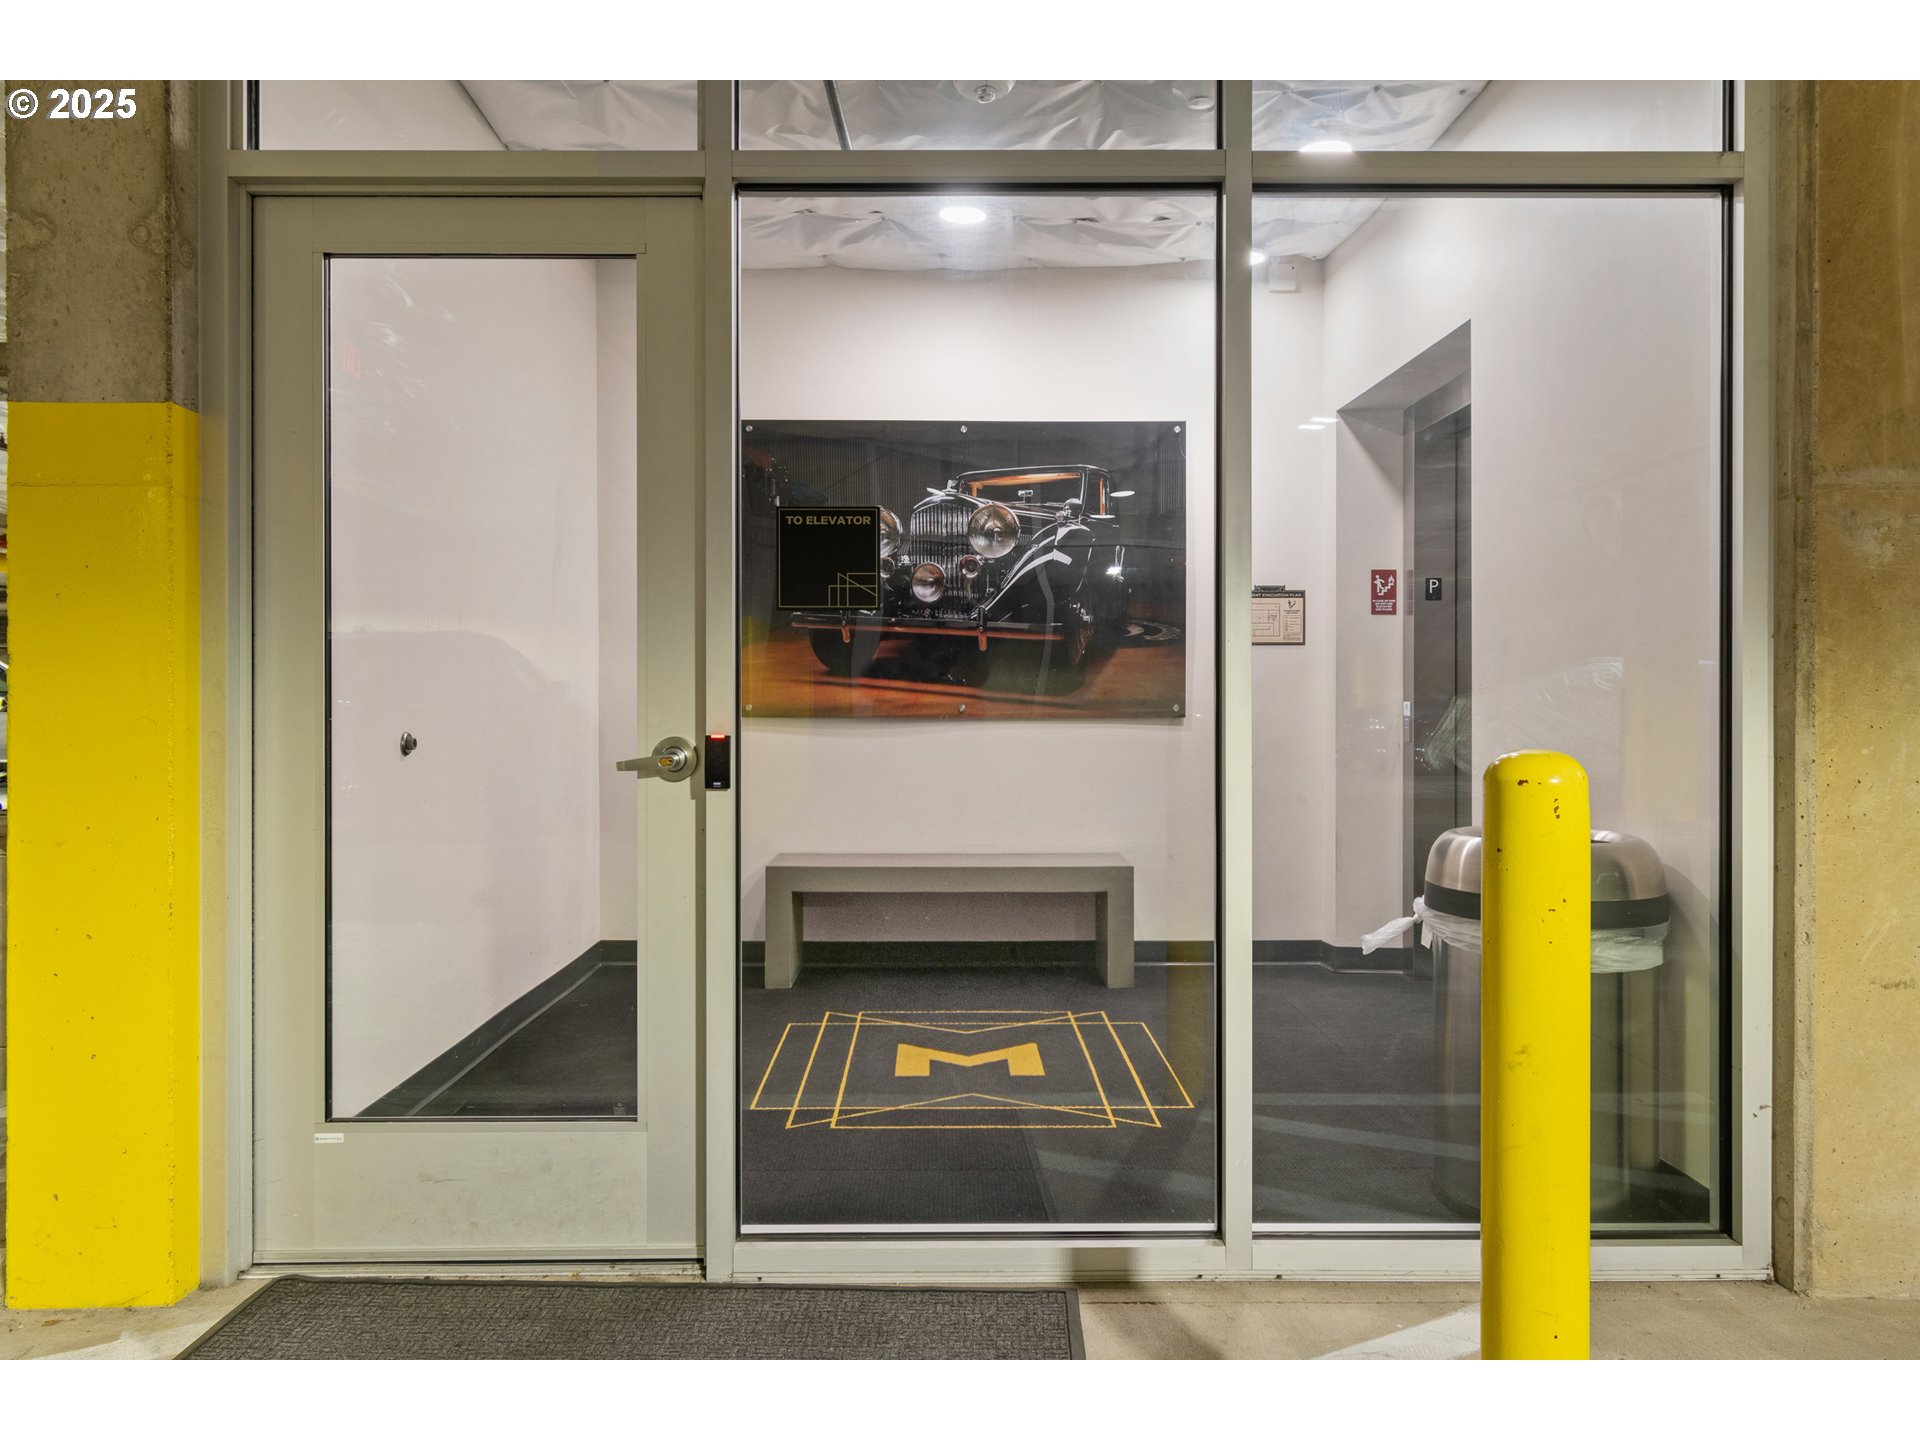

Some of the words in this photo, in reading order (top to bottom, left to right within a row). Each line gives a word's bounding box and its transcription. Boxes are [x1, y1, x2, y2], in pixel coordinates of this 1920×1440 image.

[785, 516, 803, 525] TO
[806, 516, 871, 525] ELEVATOR
[1429, 579, 1439, 594] P
